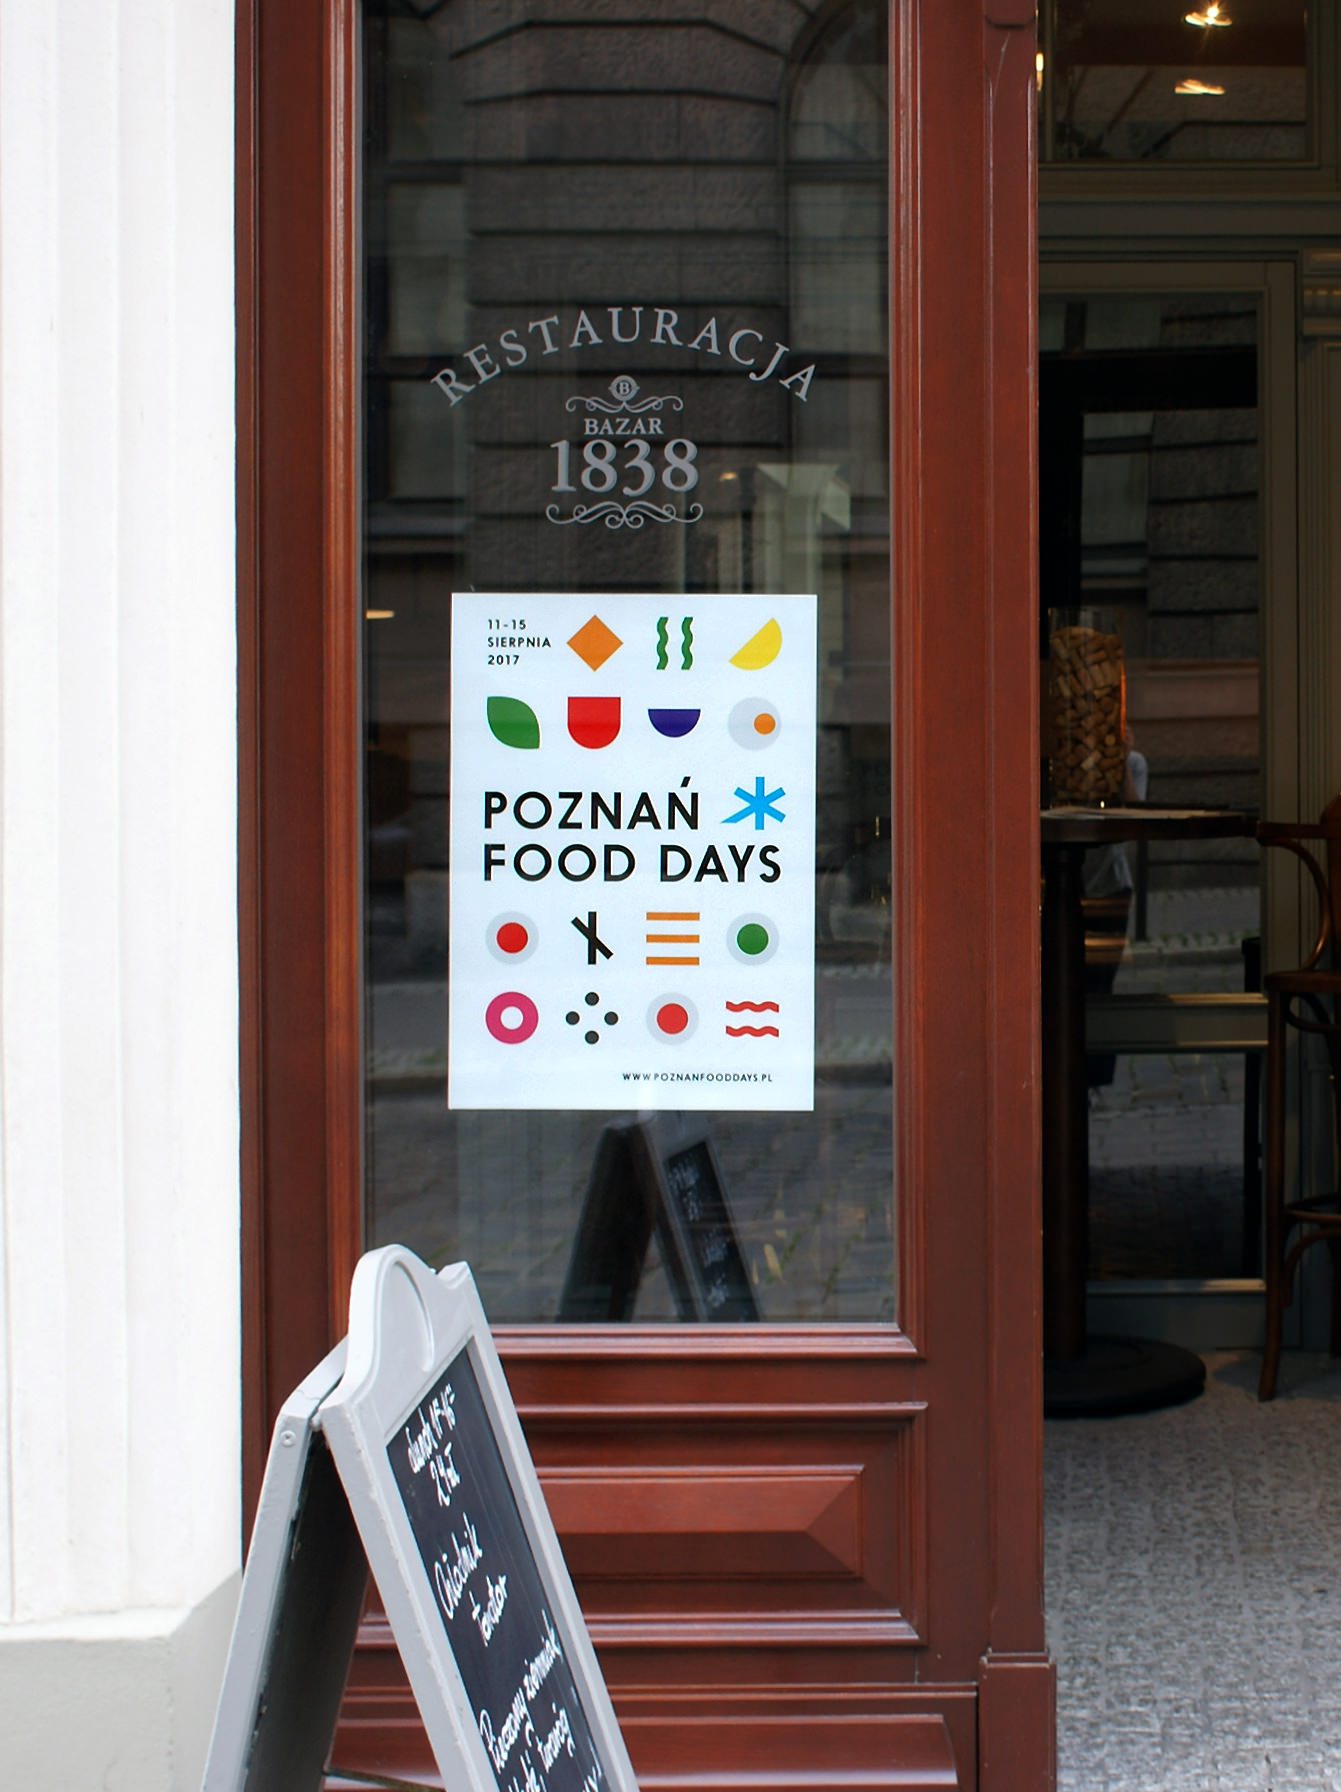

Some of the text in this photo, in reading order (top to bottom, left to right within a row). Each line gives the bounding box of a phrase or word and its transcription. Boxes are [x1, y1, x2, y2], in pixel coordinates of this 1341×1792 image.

[430, 306, 817, 408] RESTAURACJA
[584, 417, 664, 436] BAZAR
[549, 438, 699, 497] 1838
[487, 618, 527, 631] 11-15
[487, 636, 552, 649] SIERPNIA
[487, 653, 520, 666] 2017
[484, 776, 699, 831] POZNAŃ
[484, 844, 782, 884] FOOD DAYS
